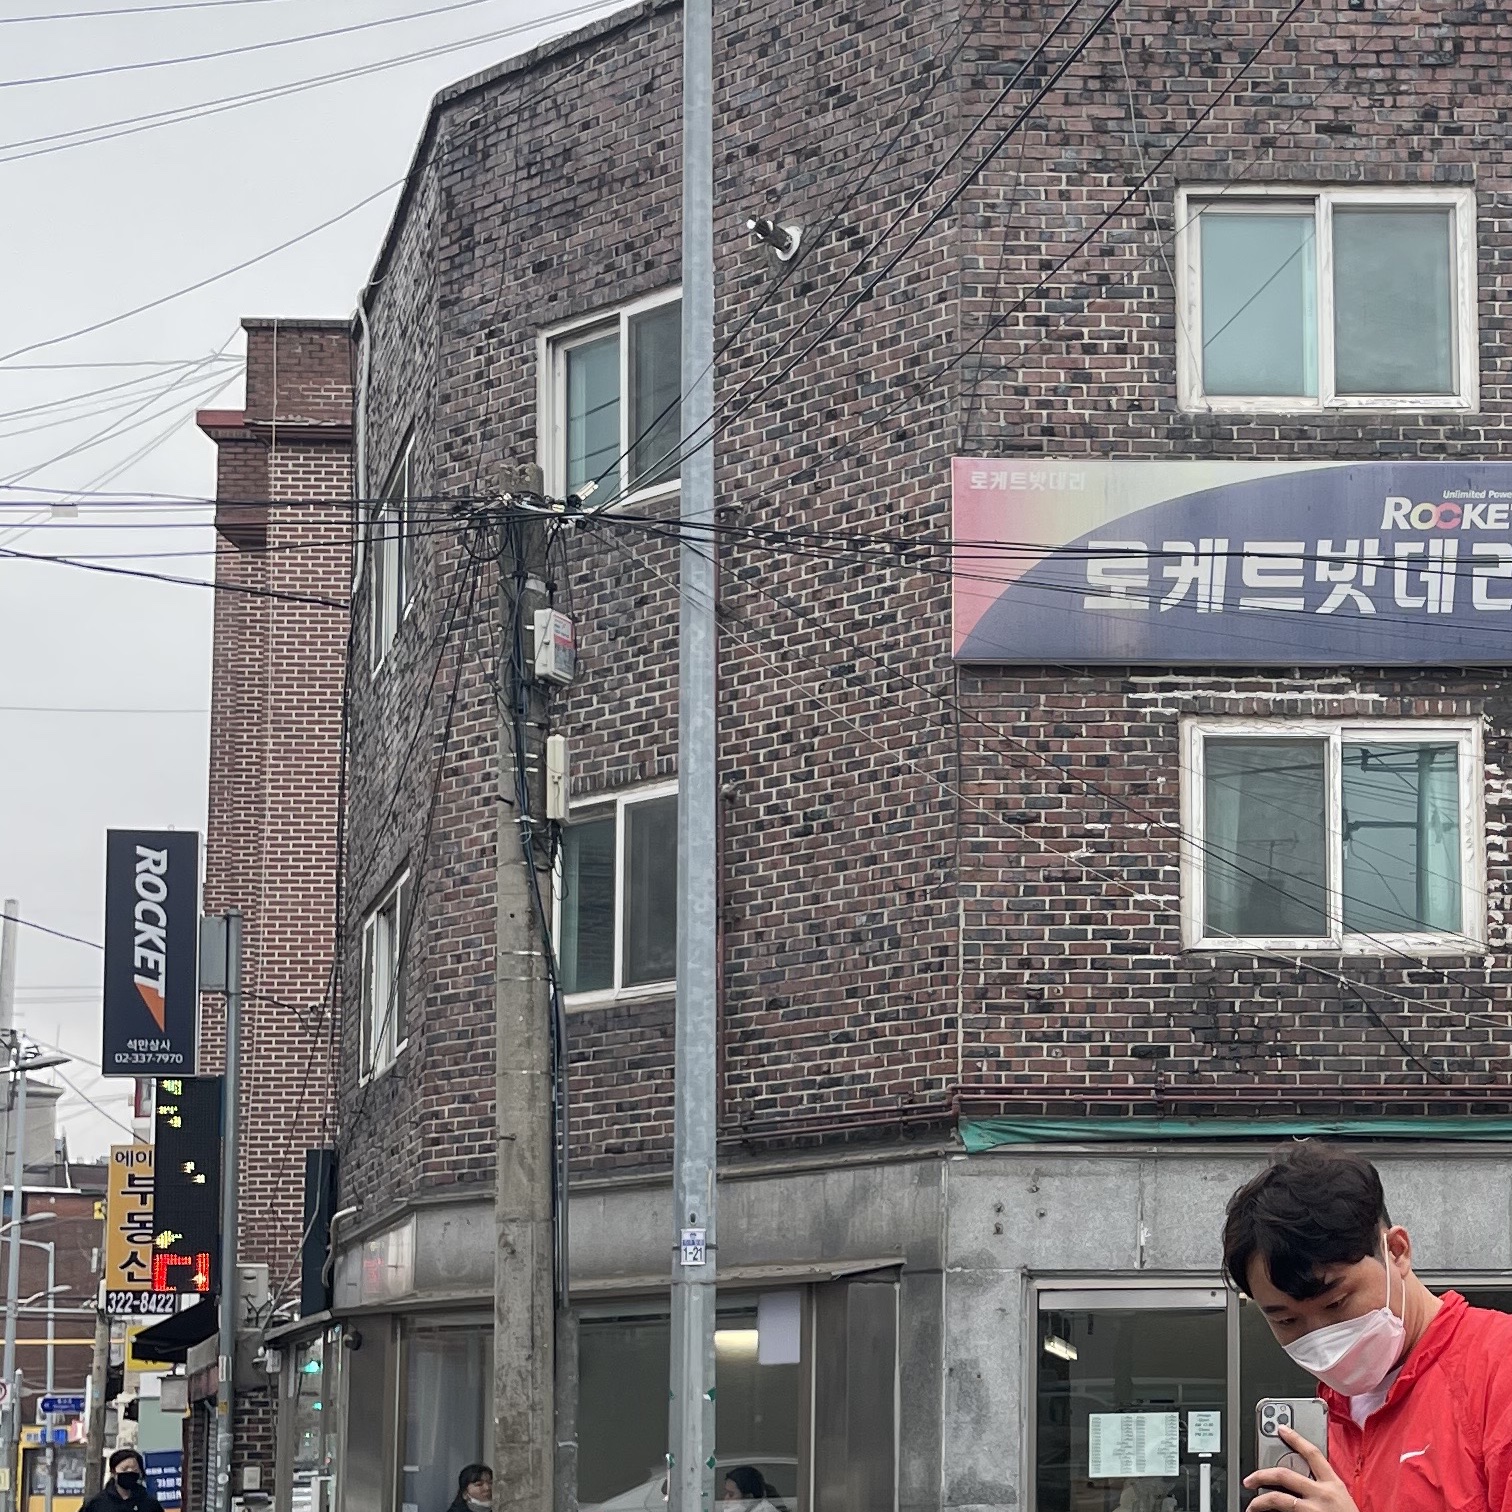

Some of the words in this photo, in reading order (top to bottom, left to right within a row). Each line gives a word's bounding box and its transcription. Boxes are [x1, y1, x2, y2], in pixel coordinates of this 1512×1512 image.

[969, 470, 1086, 491] 로케트밧데리
[1442, 489, 1486, 499] Unlimited
[134, 845, 168, 998] ROCKET
[114, 1053, 183, 1063] 02-337-7970
[683, 1245, 703, 1261] 1-21
[107, 1291, 174, 1314] 322-8422
